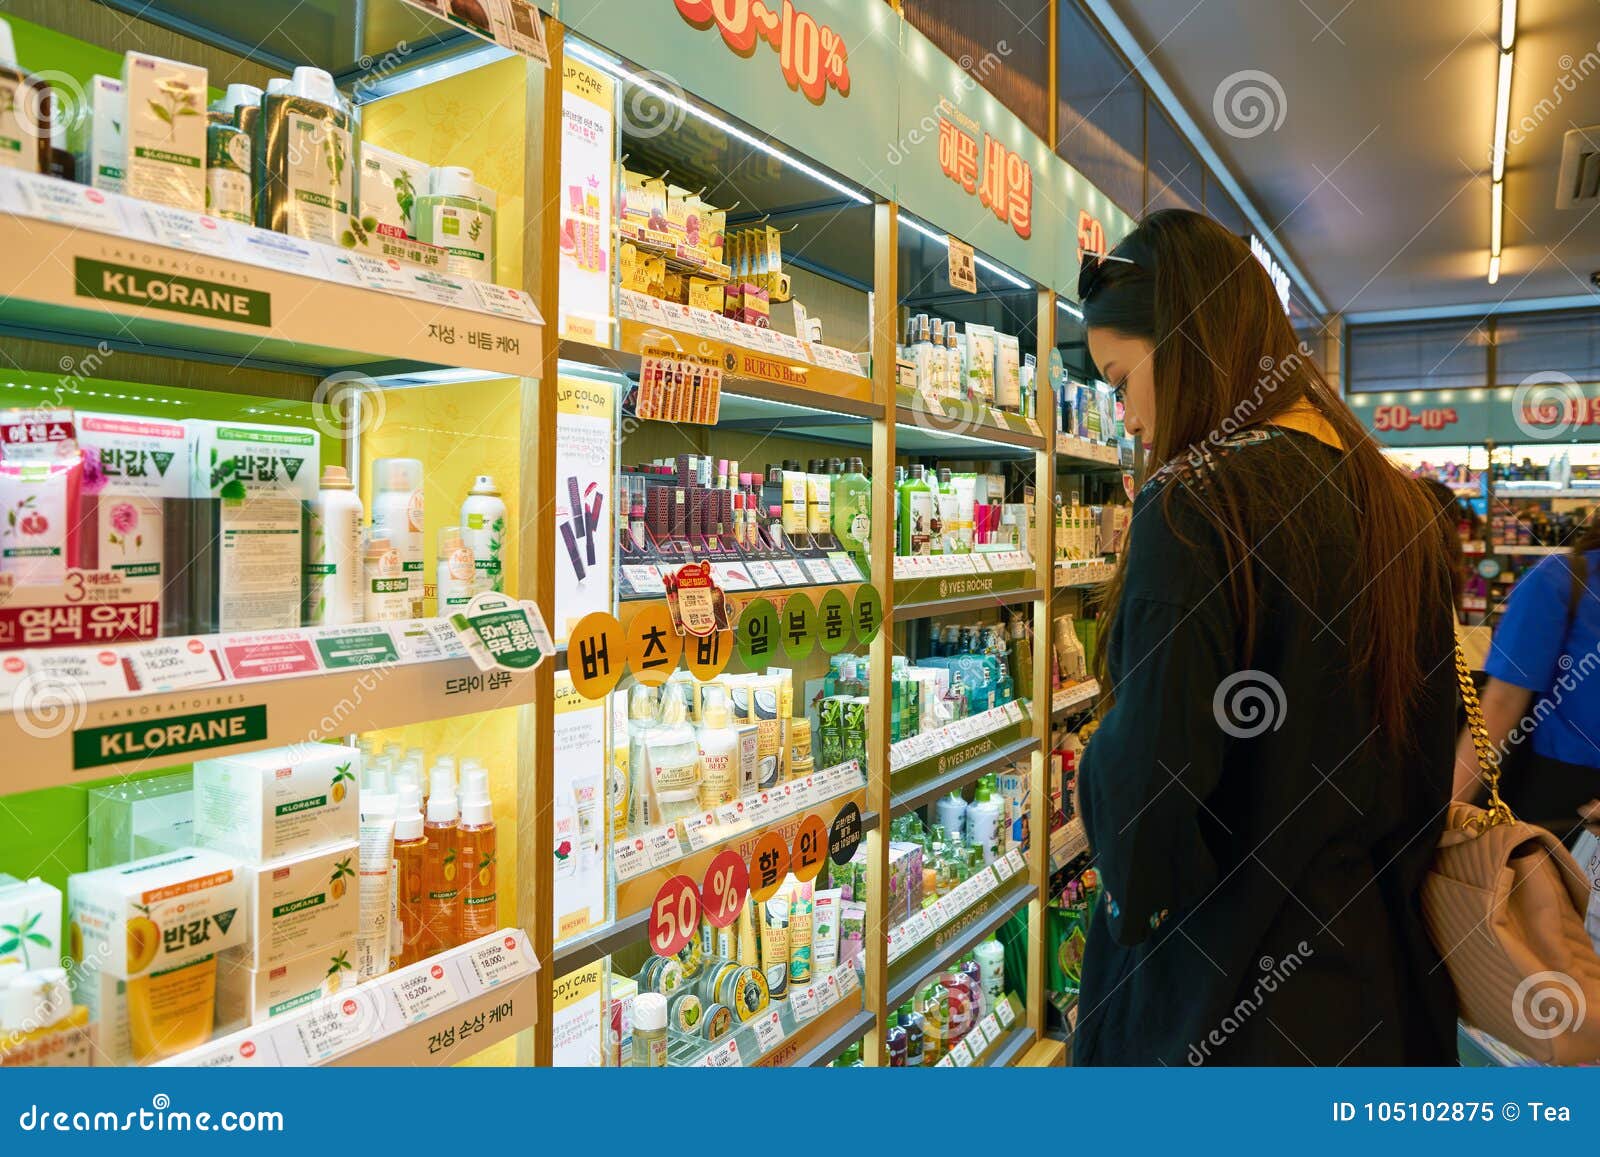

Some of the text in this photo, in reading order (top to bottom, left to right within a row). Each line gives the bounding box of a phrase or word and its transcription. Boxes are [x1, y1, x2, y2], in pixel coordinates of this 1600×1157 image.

[578, 71, 603, 94] CARE
[978, 132, 1032, 240] 세일
[380, 224, 403, 239] NEW
[101, 247, 250, 283] LABORATOIRES
[102, 270, 251, 316] KLORANE
[428, 322, 521, 356] 지성 비듬 케어
[744, 356, 781, 380] BURT'S
[783, 366, 808, 385] BEES
[574, 389, 606, 406] COLOR
[100, 447, 149, 478] 반값
[233, 454, 279, 482] 반값
[65, 572, 86, 602] 3
[948, 578, 993, 594] YVES ROCHER
[19, 606, 83, 643] 염색
[87, 603, 153, 638] 유지!
[480, 623, 509, 641] 50ml
[488, 633, 537, 657] 무료 증정
[445, 671, 513, 695] 드라이 샴푸
[100, 693, 246, 721] LABORATOIRES
[101, 716, 247, 758] KLORANE
[946, 739, 992, 769] YVES ROCHER
[282, 798, 321, 813] KLORANE
[280, 897, 321, 914] KLORANE
[962, 901, 989, 928] ROCHER
[163, 915, 212, 954] 반값
[573, 972, 598, 986] CARE
[427, 999, 514, 1055] 건성 손상 케어
